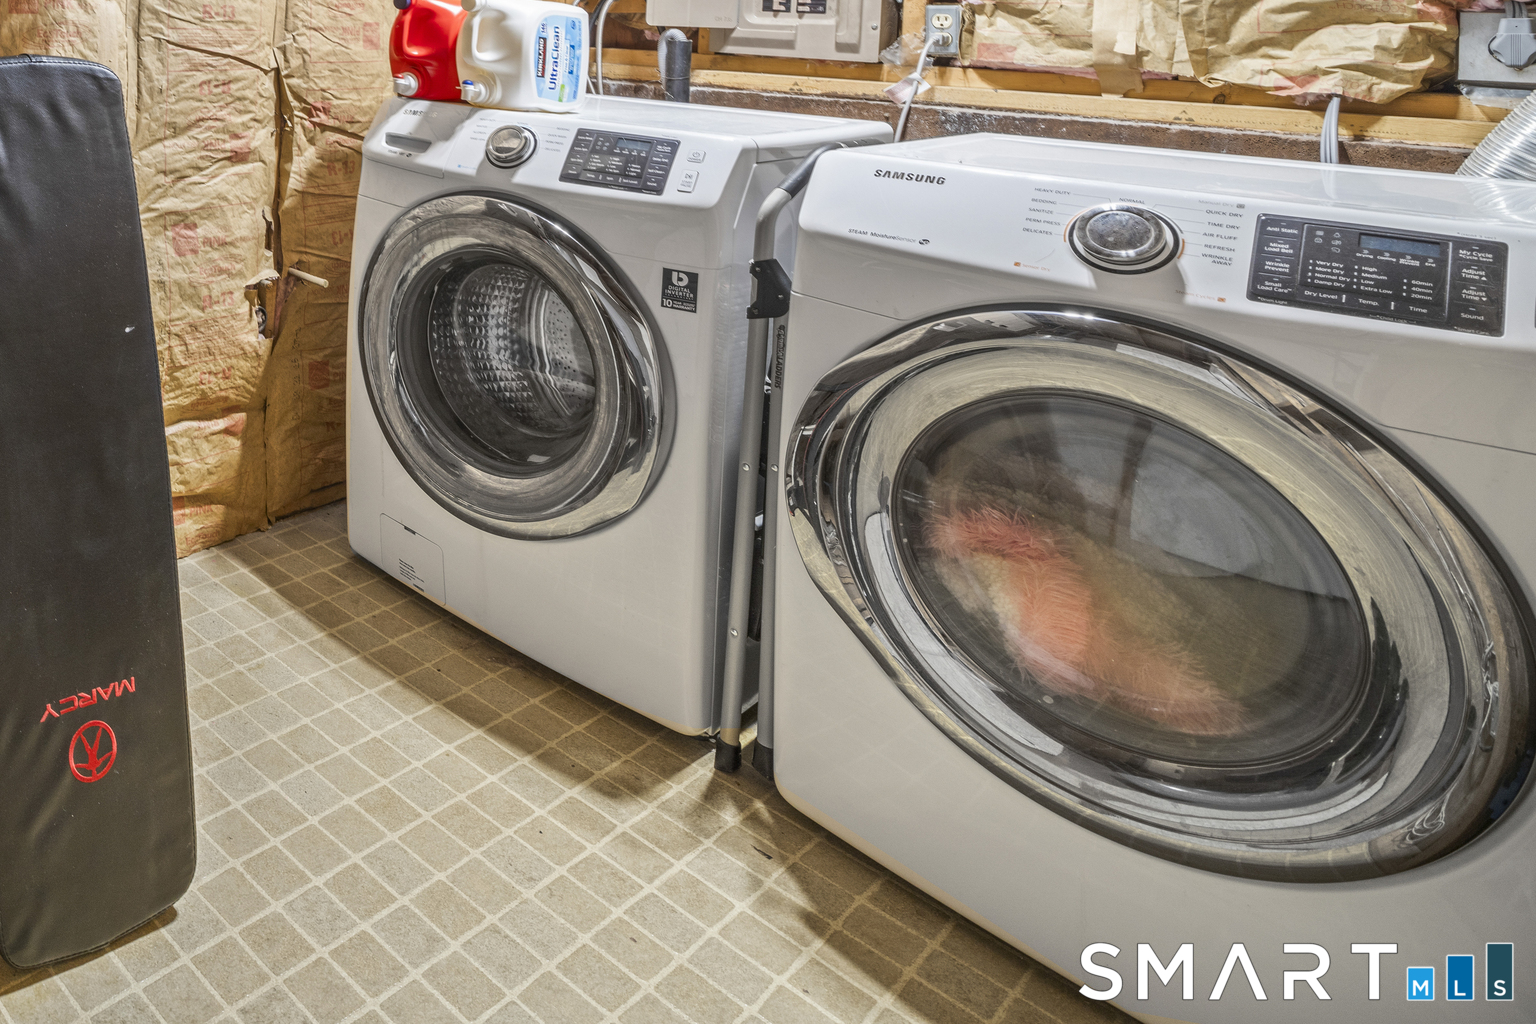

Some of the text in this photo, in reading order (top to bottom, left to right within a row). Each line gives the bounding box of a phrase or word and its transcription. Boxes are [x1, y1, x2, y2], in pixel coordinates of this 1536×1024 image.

[202, 5, 236, 20] R-13
[548, 26, 560, 90] UltraClean
[198, 80, 232, 95] R-13
[327, 160, 356, 176] R-13
[874, 169, 946, 185] SAMSUNG
[1023, 227, 1053, 235] DELICATES
[202, 235, 228, 247] PINK
[1204, 244, 1235, 252] REFRESH
[1201, 253, 1233, 262] WRINKLE
[1264, 265, 1289, 273] Prevent
[1462, 268, 1485, 276] Adjust
[665, 289, 693, 297] INVERTER
[669, 285, 690, 293] DIGITAL
[1360, 285, 1378, 293] Extra
[1411, 286, 1433, 294] 40min
[1411, 293, 1433, 301] 20min
[663, 299, 672, 307] 10
[1358, 298, 1380, 306] Temp.
[1409, 306, 1428, 314] Time
[1461, 313, 1484, 321] Sound
[775, 357, 783, 389] LADDERS
[40, 676, 136, 723] MARCY
